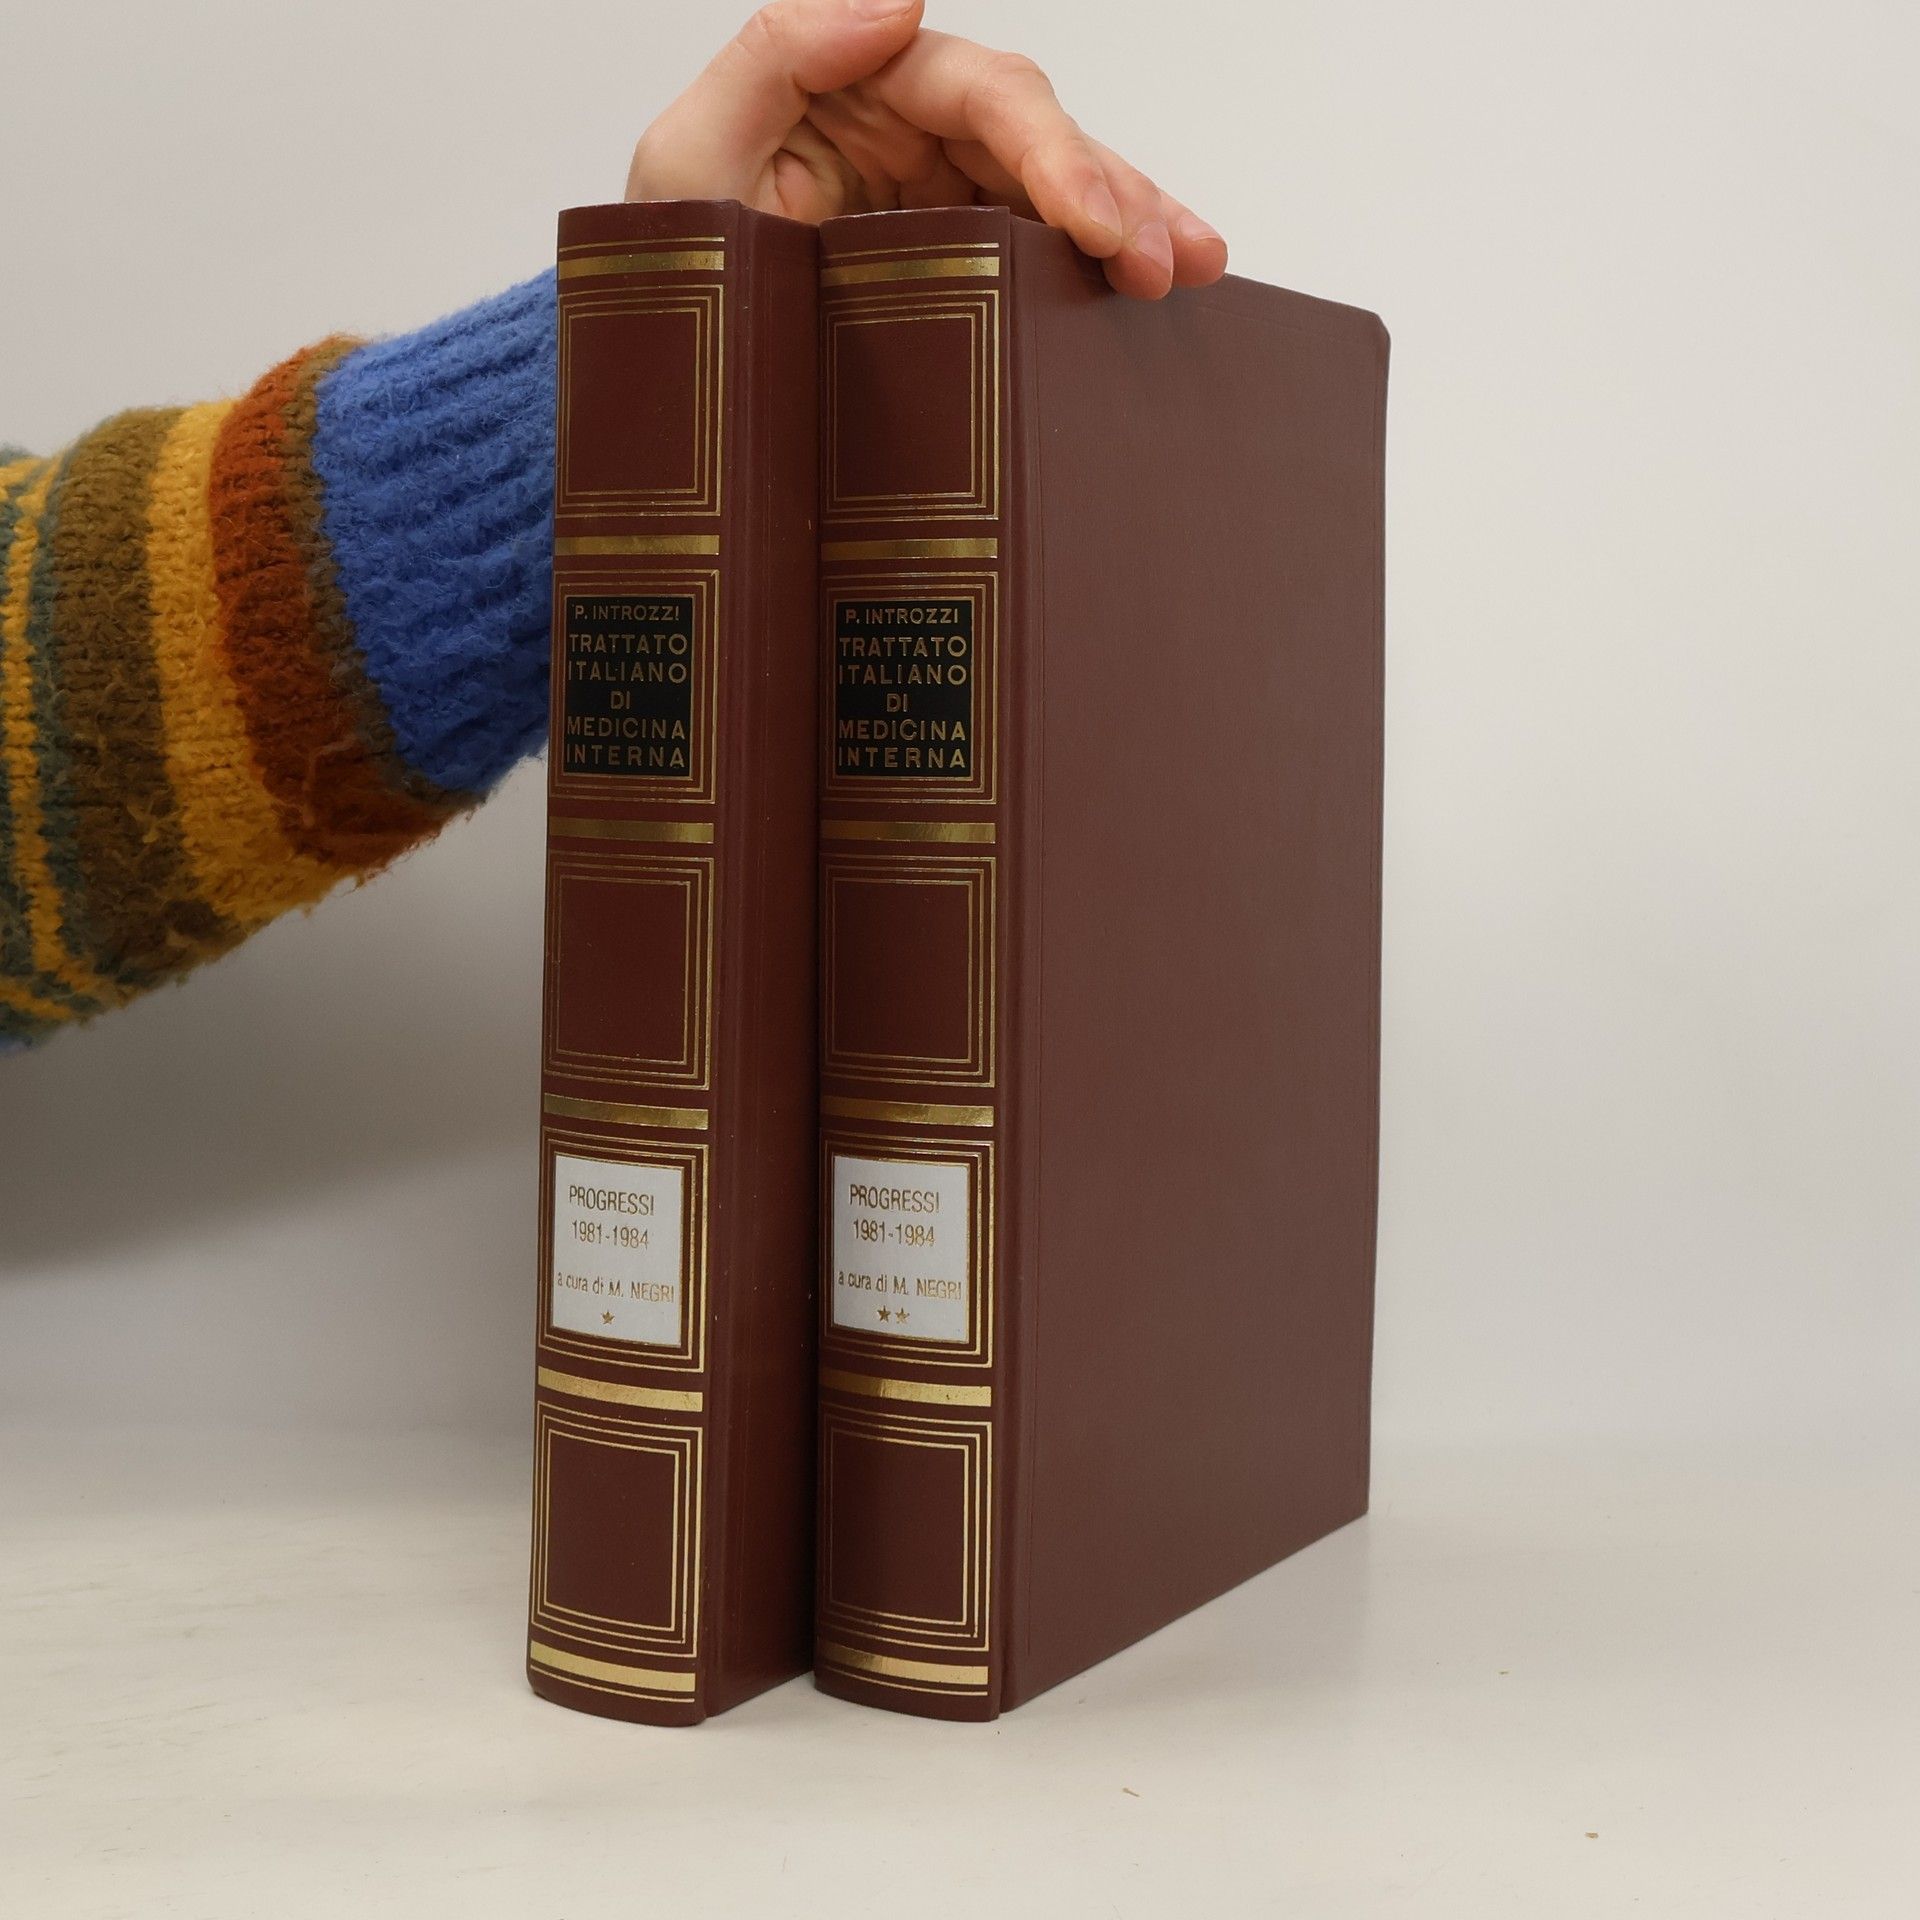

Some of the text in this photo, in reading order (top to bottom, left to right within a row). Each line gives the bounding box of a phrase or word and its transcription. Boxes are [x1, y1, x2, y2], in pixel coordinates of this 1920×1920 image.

[575, 605, 679, 621] P. INTROZZI
[846, 608, 958, 624] P. INTROZZI
[569, 634, 687, 655] TRATTATO
[840, 636, 966, 657] TRATTATO
[569, 661, 687, 683] ITALIANO
[840, 665, 966, 685] ITALIANO
[610, 691, 630, 709] DI
[886, 693, 907, 712] DI
[567, 716, 685, 739] MEDICINA
[839, 719, 965, 741] MEDICINA
[567, 744, 685, 768] INTERNA
[839, 747, 965, 768] INTERNA
[569, 1185, 654, 1216] PROGRESSI
[850, 1184, 939, 1213] PROGRESSI
[572, 1220, 649, 1250] 1981-1984
[854, 1219, 934, 1247] 1981-1984
[558, 1272, 674, 1303] a cura di M. NEGRI
[839, 1271, 961, 1299] a cura di M. NEGRI
